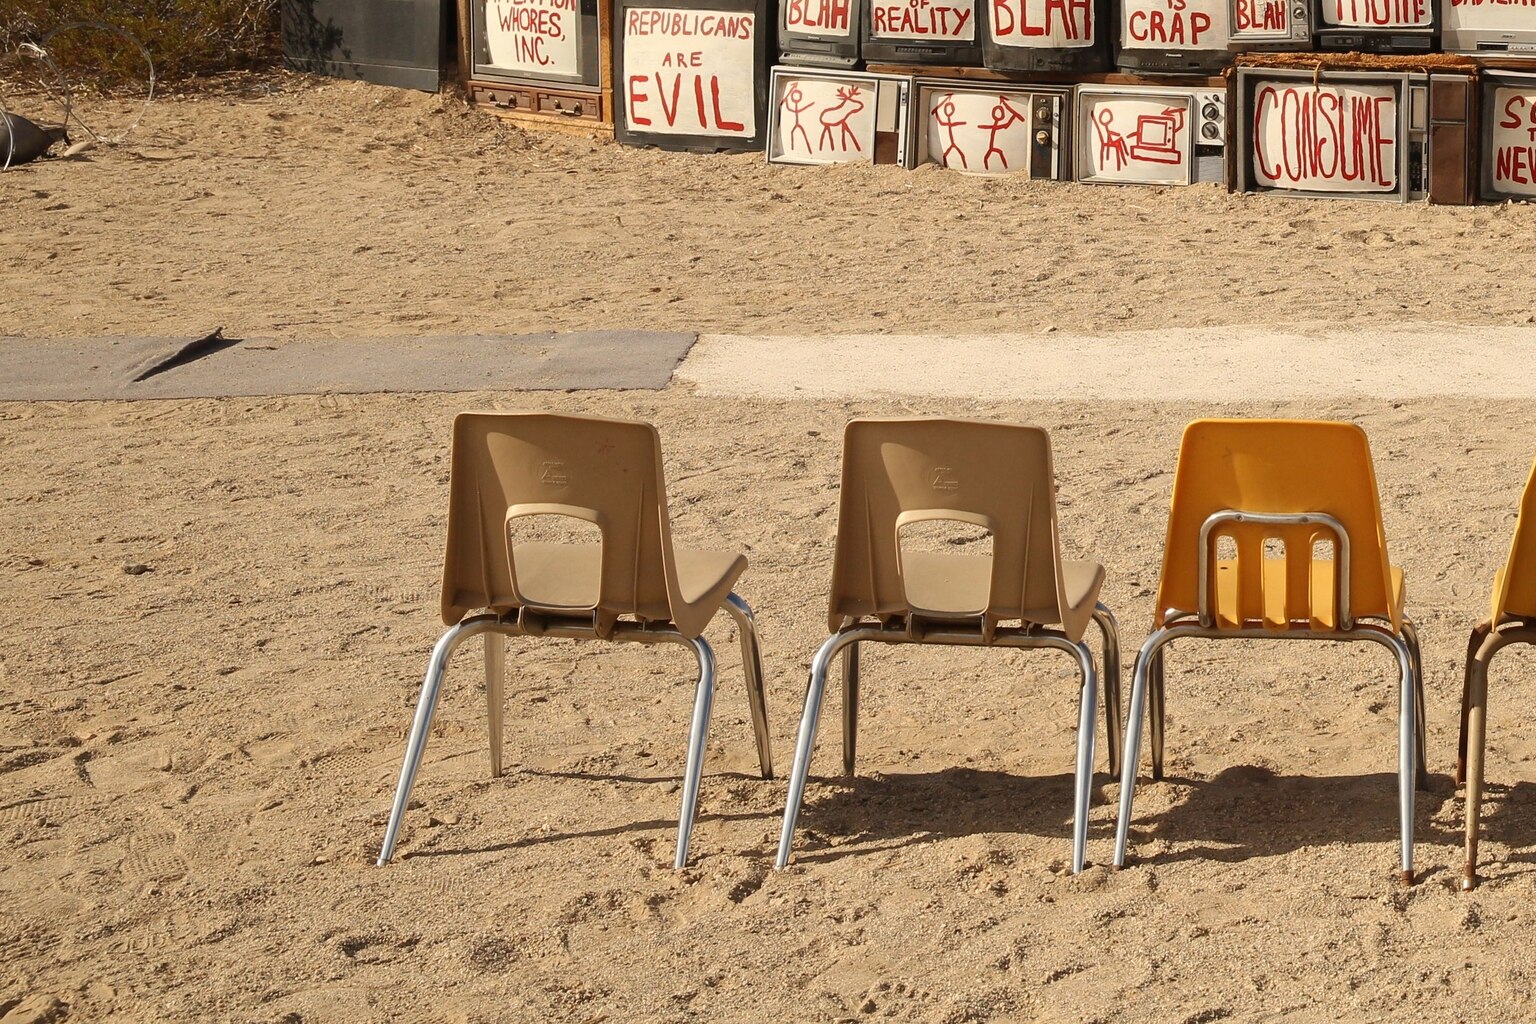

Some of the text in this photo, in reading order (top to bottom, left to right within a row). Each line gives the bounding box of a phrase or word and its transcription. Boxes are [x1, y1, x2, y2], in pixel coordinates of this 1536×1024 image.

[497, 6, 566, 41] WHORES,
[628, 10, 752, 39] REPUBLICANS
[874, 6, 970, 35] REALITY
[1129, 10, 1211, 45] CRAP
[514, 34, 555, 65] INC.
[662, 52, 703, 67] ARE
[630, 73, 744, 131] EVIL
[1254, 86, 1393, 187] CONSUME
